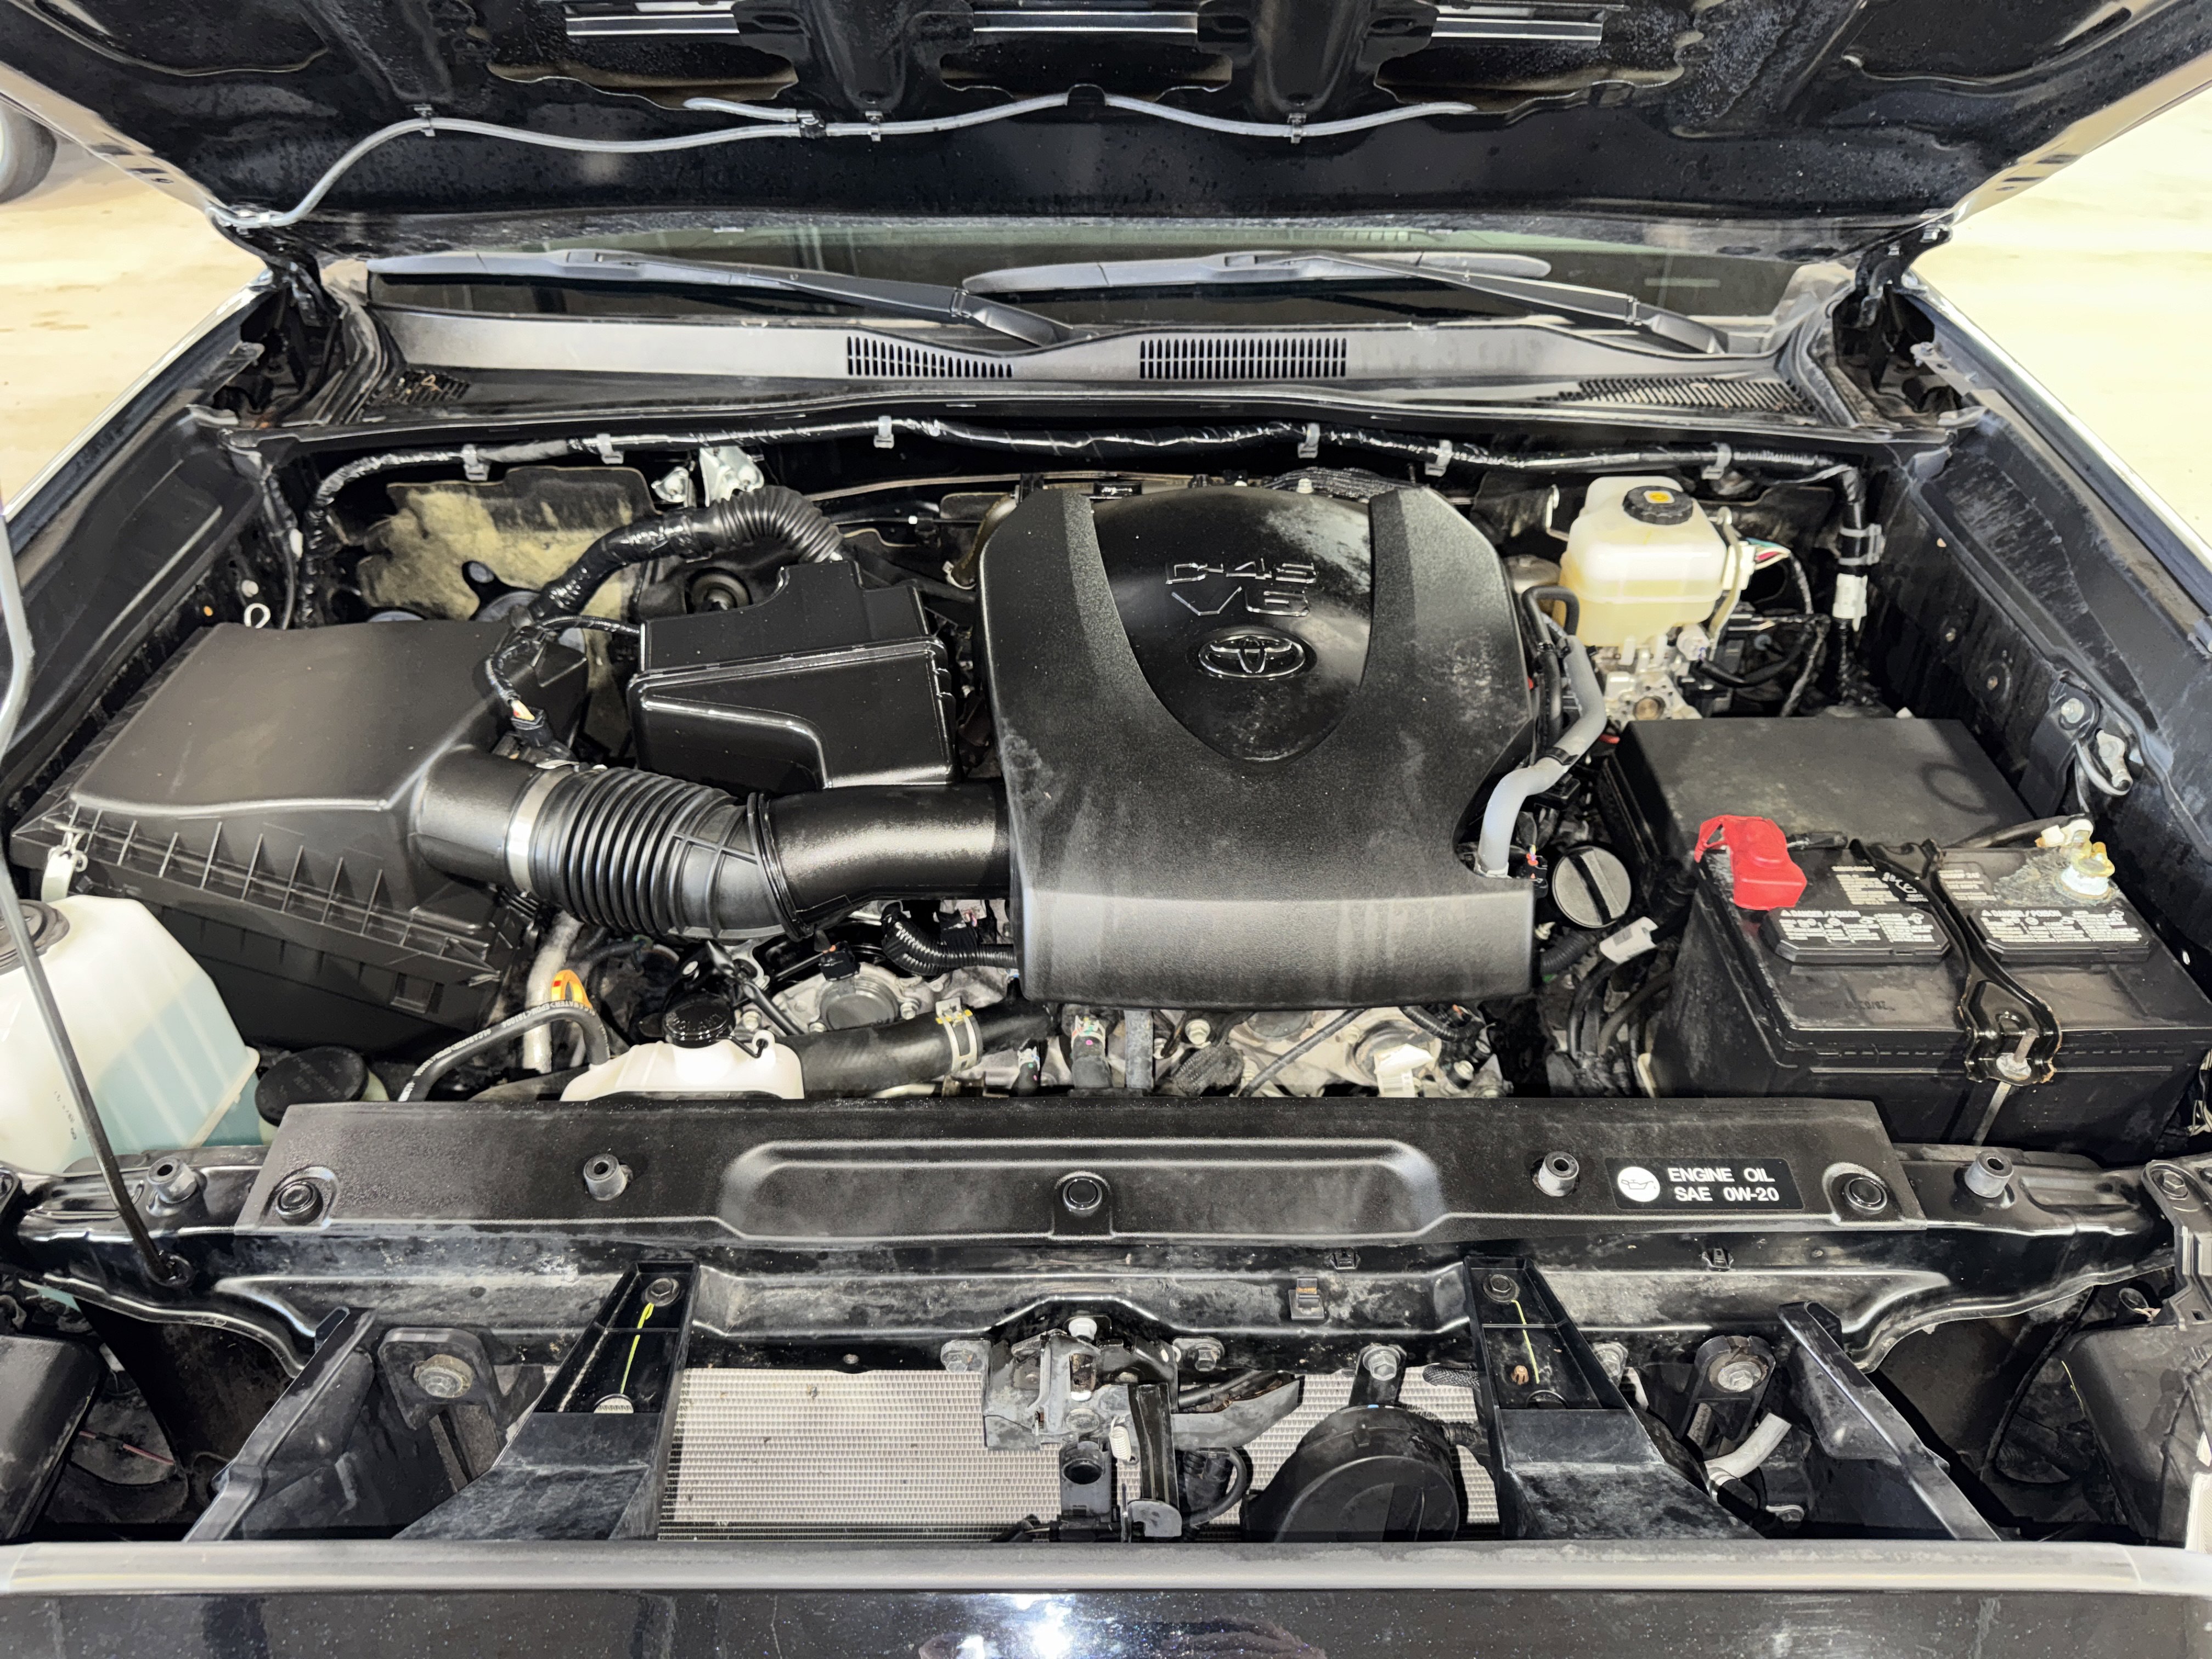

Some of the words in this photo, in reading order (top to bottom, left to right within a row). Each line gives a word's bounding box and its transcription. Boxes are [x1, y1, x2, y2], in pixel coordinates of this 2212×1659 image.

[1165, 558, 1318, 585] D-4S
[1171, 586, 1310, 617] V6
[1667, 1167, 1735, 1182] ENGINE
[1743, 1167, 1776, 1182] OIL
[1674, 1186, 1713, 1201] SAE
[1722, 1186, 1780, 1201] 0W-20
